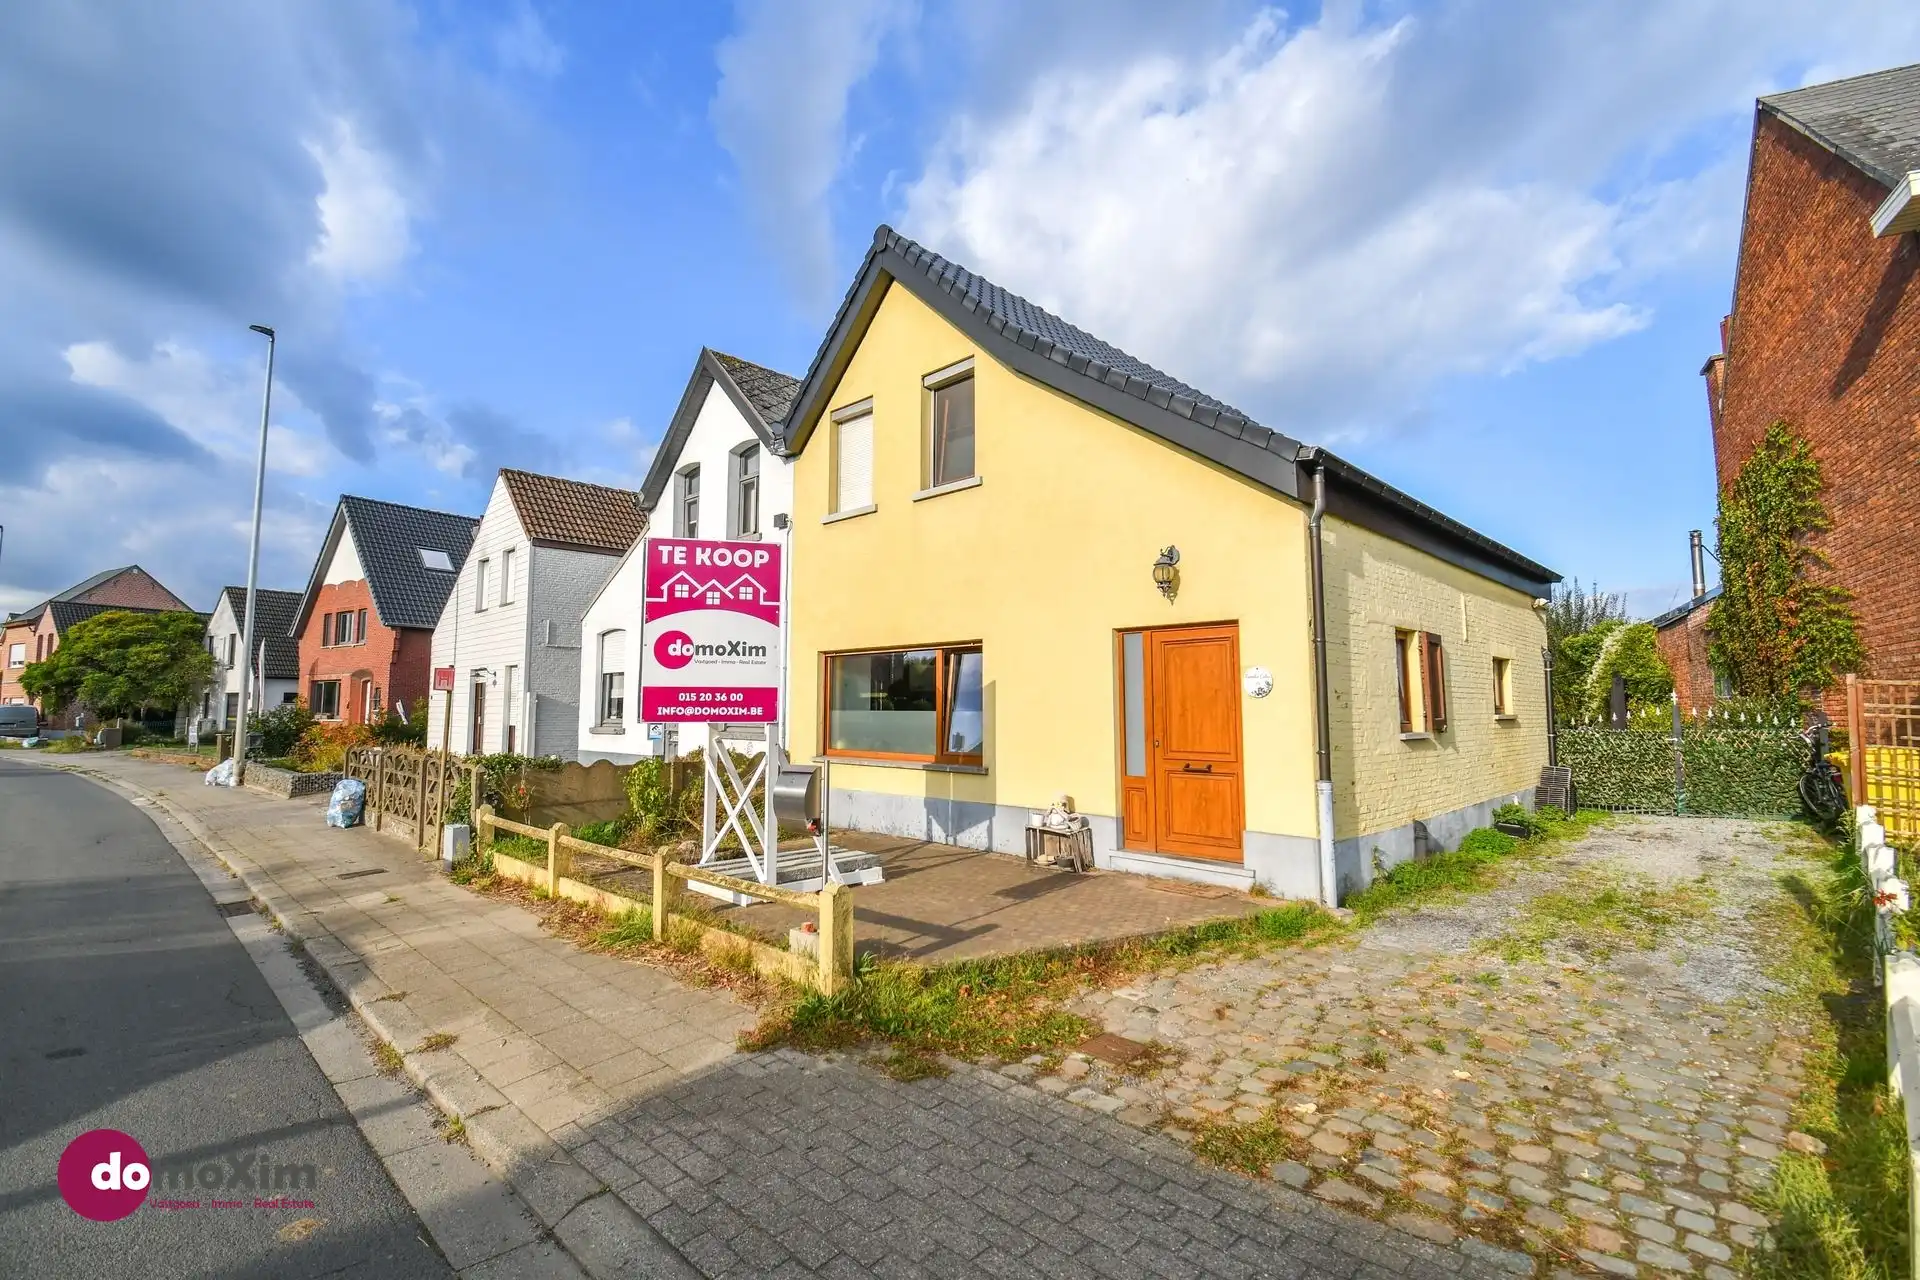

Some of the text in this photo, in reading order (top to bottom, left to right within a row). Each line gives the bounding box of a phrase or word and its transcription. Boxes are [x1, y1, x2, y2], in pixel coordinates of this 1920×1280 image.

[658, 545, 770, 568] TE KOOP
[667, 639, 767, 657] domoXim
[678, 693, 744, 701] 015 20 36 00
[657, 706, 763, 716] INFO@DOMOXIM.BE
